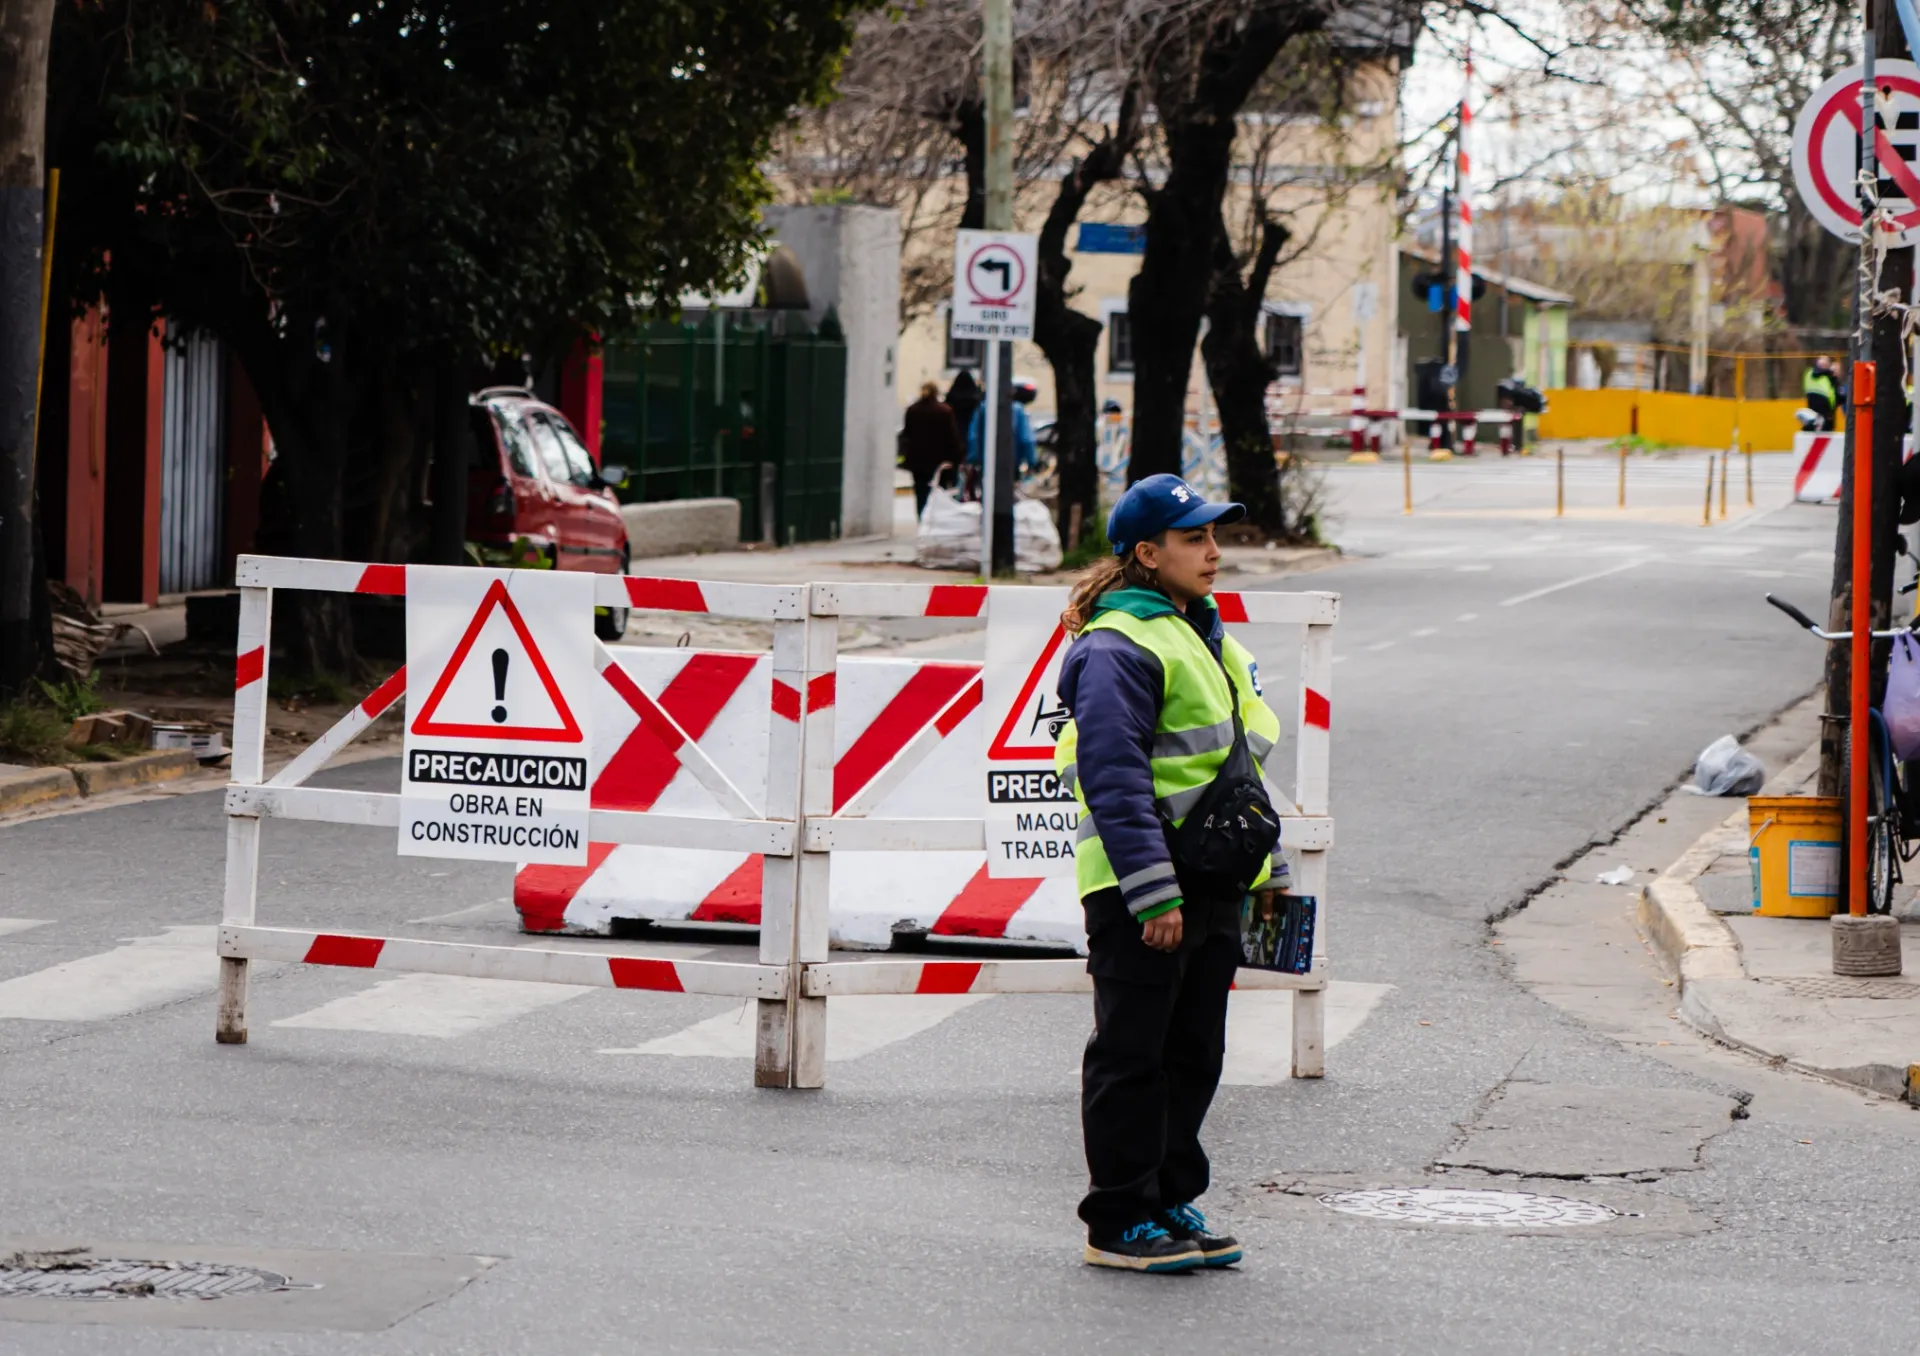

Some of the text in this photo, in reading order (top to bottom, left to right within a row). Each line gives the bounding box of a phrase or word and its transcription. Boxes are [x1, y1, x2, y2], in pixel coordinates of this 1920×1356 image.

[414, 754, 582, 786] PRECAUCION
[450, 793, 543, 817] OBRA EN
[1016, 812, 1078, 832] MAQU
[411, 820, 579, 849] CONSTRUCCIÓN
[1001, 840, 1075, 859] TRABA
